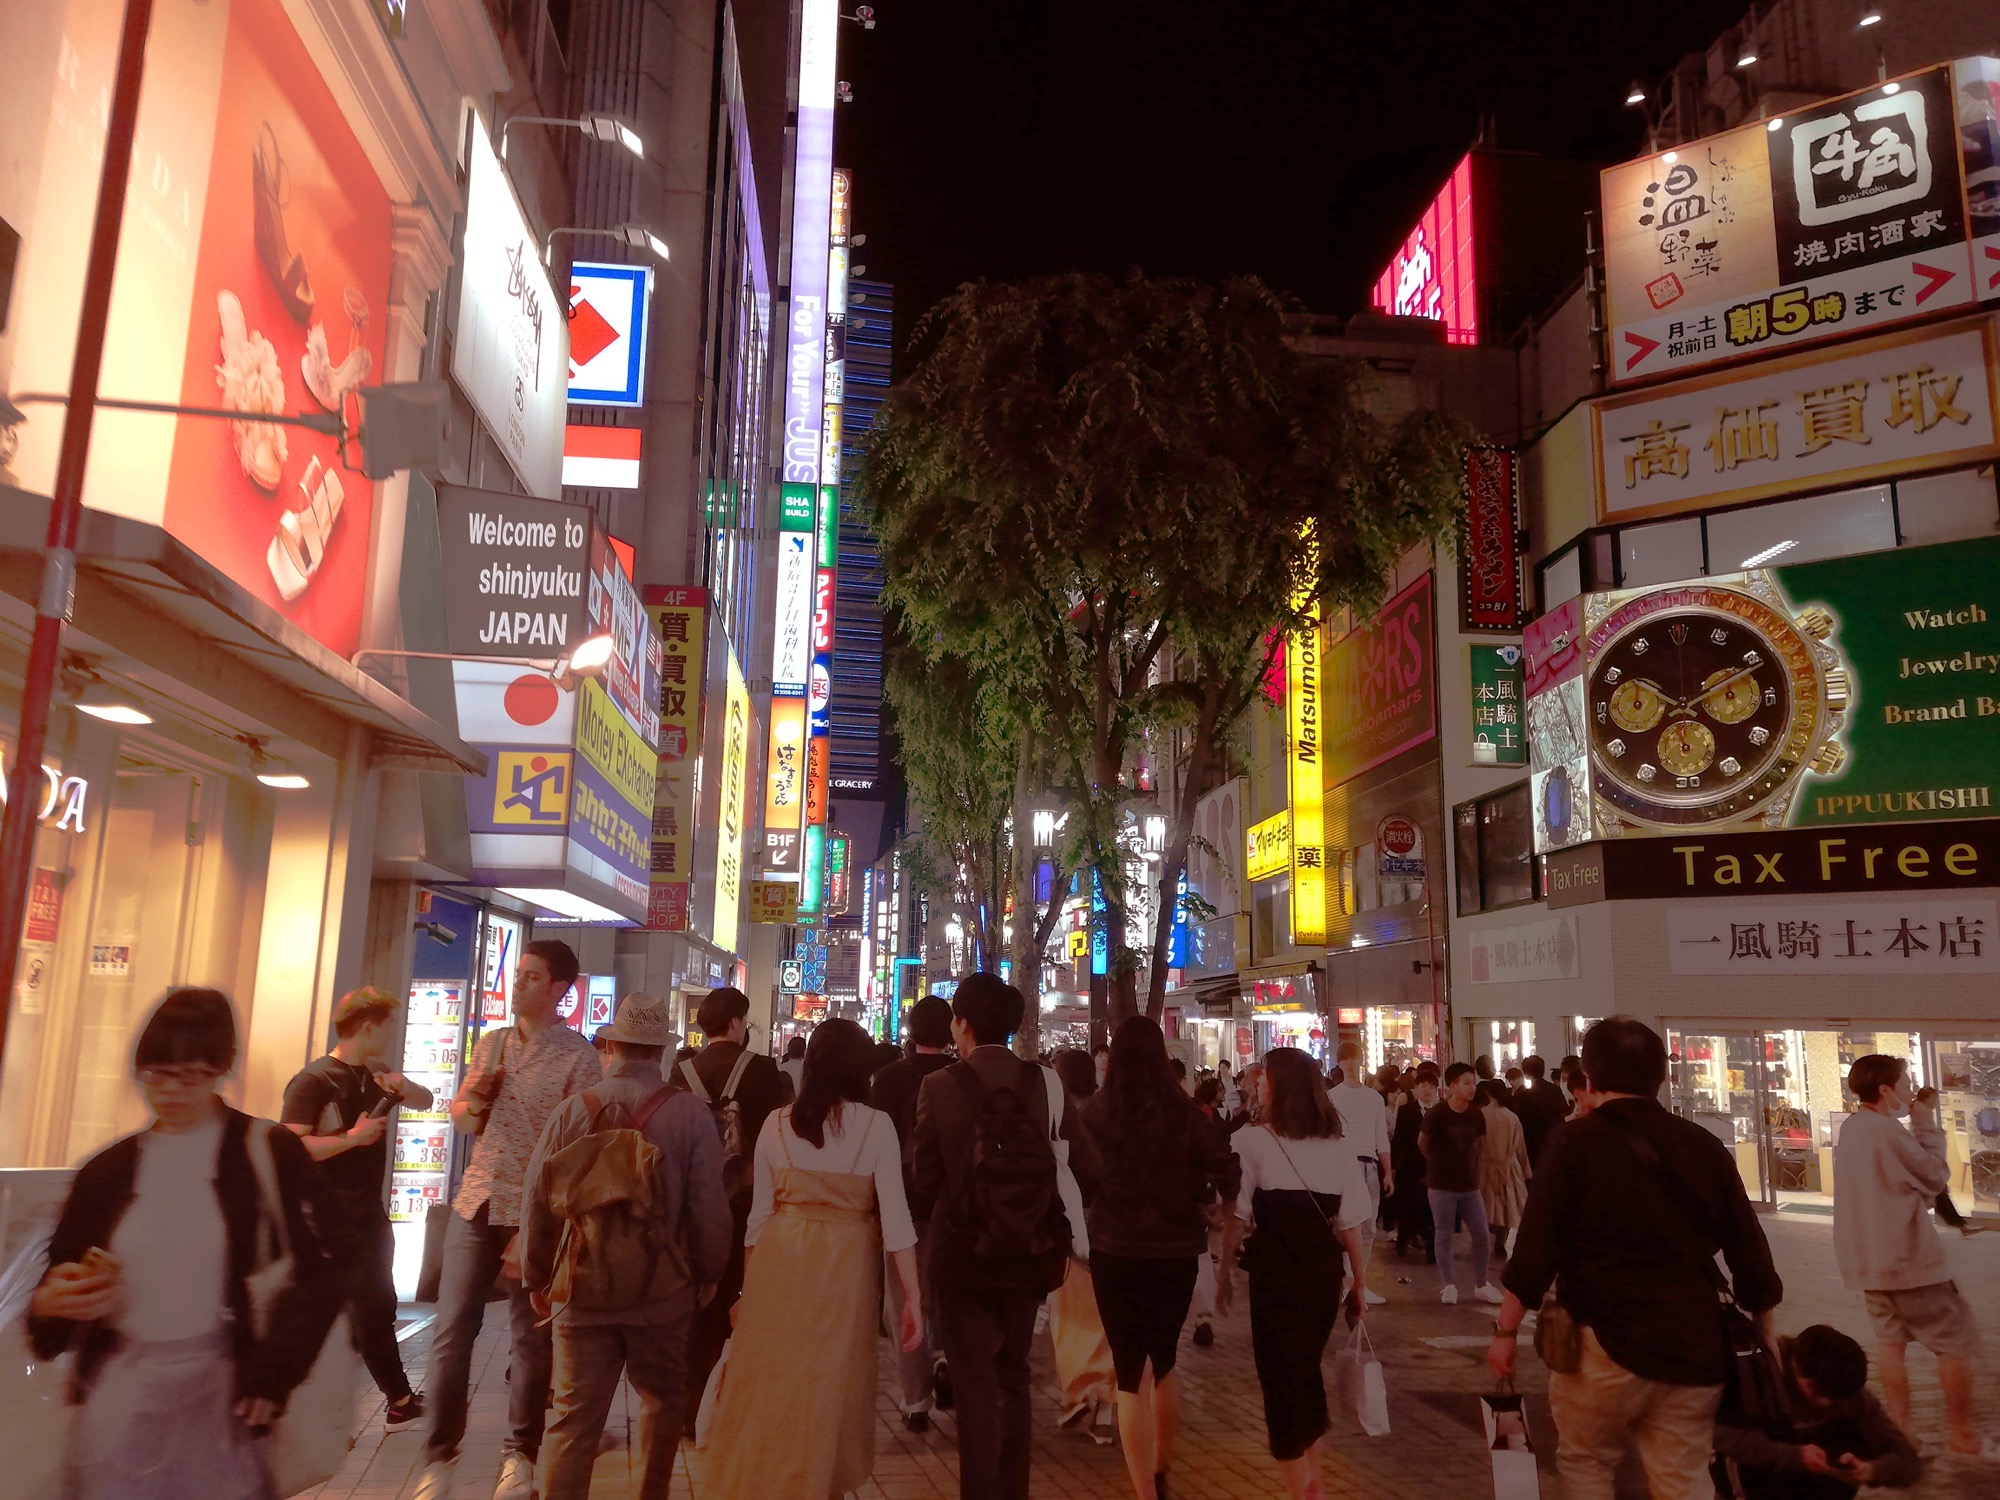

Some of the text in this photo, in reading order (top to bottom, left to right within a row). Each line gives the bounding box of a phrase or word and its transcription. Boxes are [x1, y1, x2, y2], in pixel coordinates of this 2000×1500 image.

[1812, 127, 1916, 189] 牛角
[1794, 209, 1946, 266] 焼肉酒家
[1729, 289, 1843, 343] 朝5時
[792, 295, 821, 399] For Your
[1667, 335, 1716, 358] 祝前日
[1620, 363, 1972, 488] 高価買取
[785, 497, 809, 507] SHA
[785, 509, 809, 518] BUILD
[469, 513, 583, 548] Welcome to
[479, 562, 581, 598] shinjyuku
[663, 591, 687, 605] 4F
[480, 611, 567, 645] JAPAN
[1904, 604, 1988, 630] Watch
[1900, 651, 2000, 679] Jewelry
[1474, 682, 1496, 726] 本店
[1884, 698, 1967, 725] Brand
[581, 684, 614, 771] Money
[835, 780, 872, 789] GRACERY
[1817, 787, 1990, 815] IPPUUKISHI
[767, 834, 795, 846] B1F
[1386, 830, 1413, 843] 消火栓
[1297, 847, 1321, 868] 薬
[1673, 838, 1977, 887] Tax Free
[1551, 863, 1599, 891] Tax Free
[650, 900, 677, 912] REE
[651, 886, 679, 898] UTY
[650, 914, 679, 926] HOP
[1680, 916, 1984, 961] 一風騎士本店
